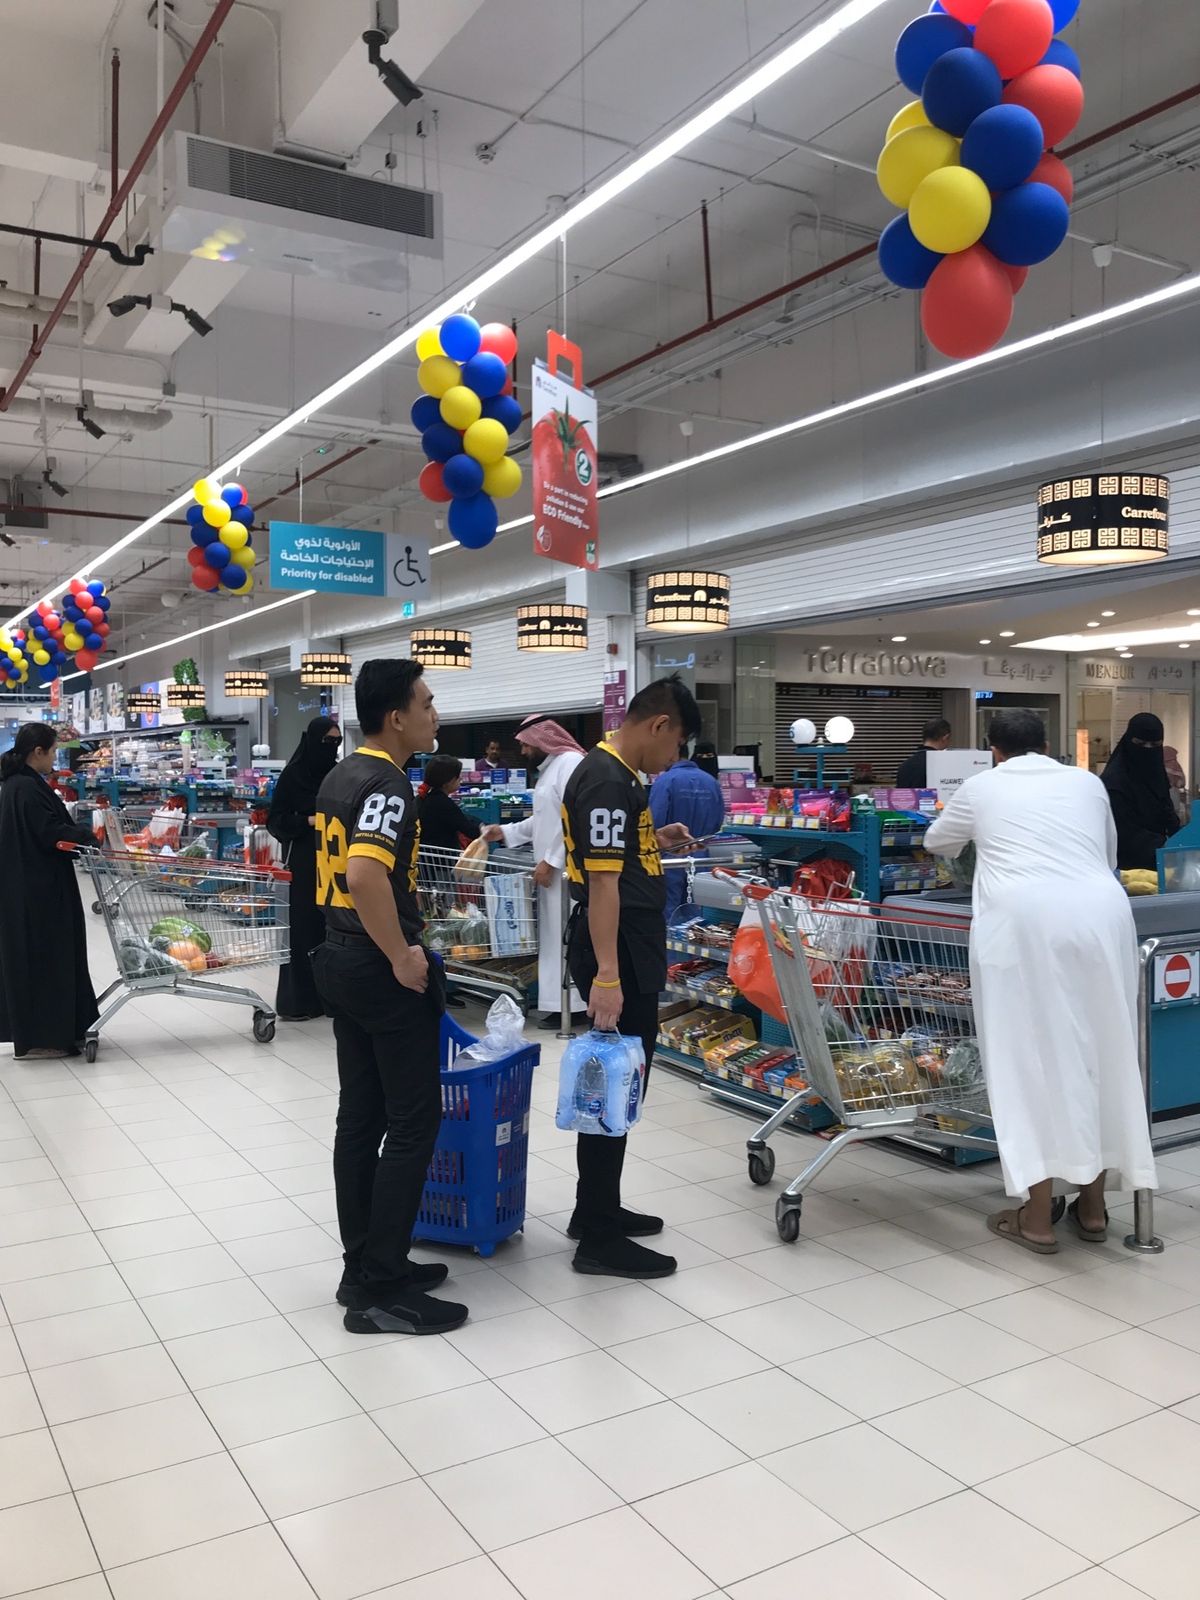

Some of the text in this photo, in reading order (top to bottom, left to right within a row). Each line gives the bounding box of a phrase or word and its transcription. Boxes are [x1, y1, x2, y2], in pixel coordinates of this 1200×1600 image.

[579, 452, 589, 476] 2
[543, 503, 557, 517] ECO
[1121, 506, 1167, 522] Carrefour
[294, 537, 360, 552] الأولوية لذوي
[280, 549, 319, 563] الخاصة
[281, 567, 374, 584] Priority for disabled
[357, 792, 405, 841] 82
[590, 807, 627, 848] 82
